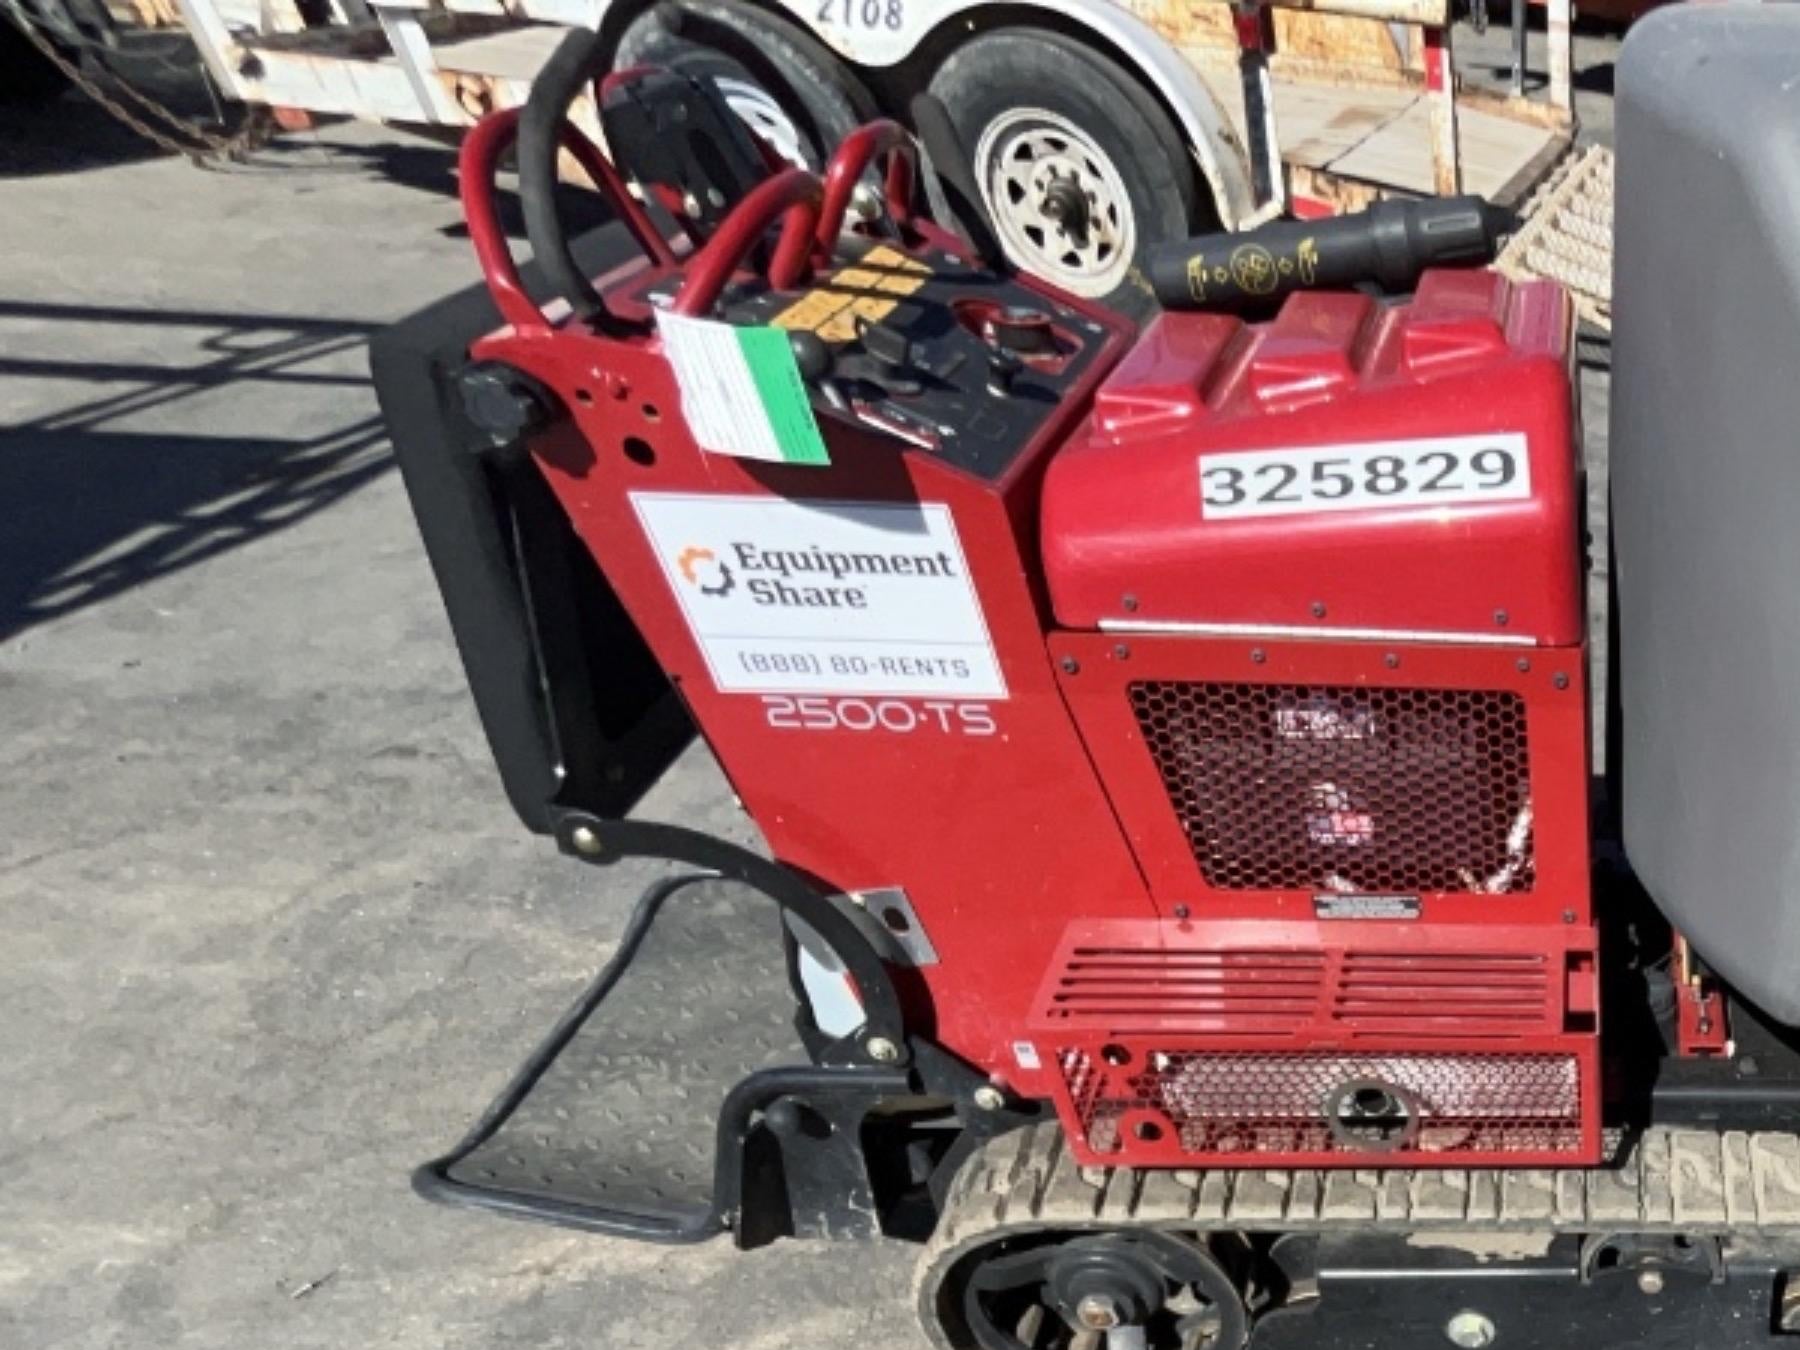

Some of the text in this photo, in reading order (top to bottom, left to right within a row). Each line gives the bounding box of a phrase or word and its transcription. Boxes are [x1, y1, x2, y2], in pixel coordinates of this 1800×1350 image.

[817, 0, 903, 30] 2108
[1202, 448, 1517, 507] 325829
[731, 542, 957, 578] Equipment
[747, 578, 867, 609] Share
[738, 651, 971, 678] (888) 80-RENTS
